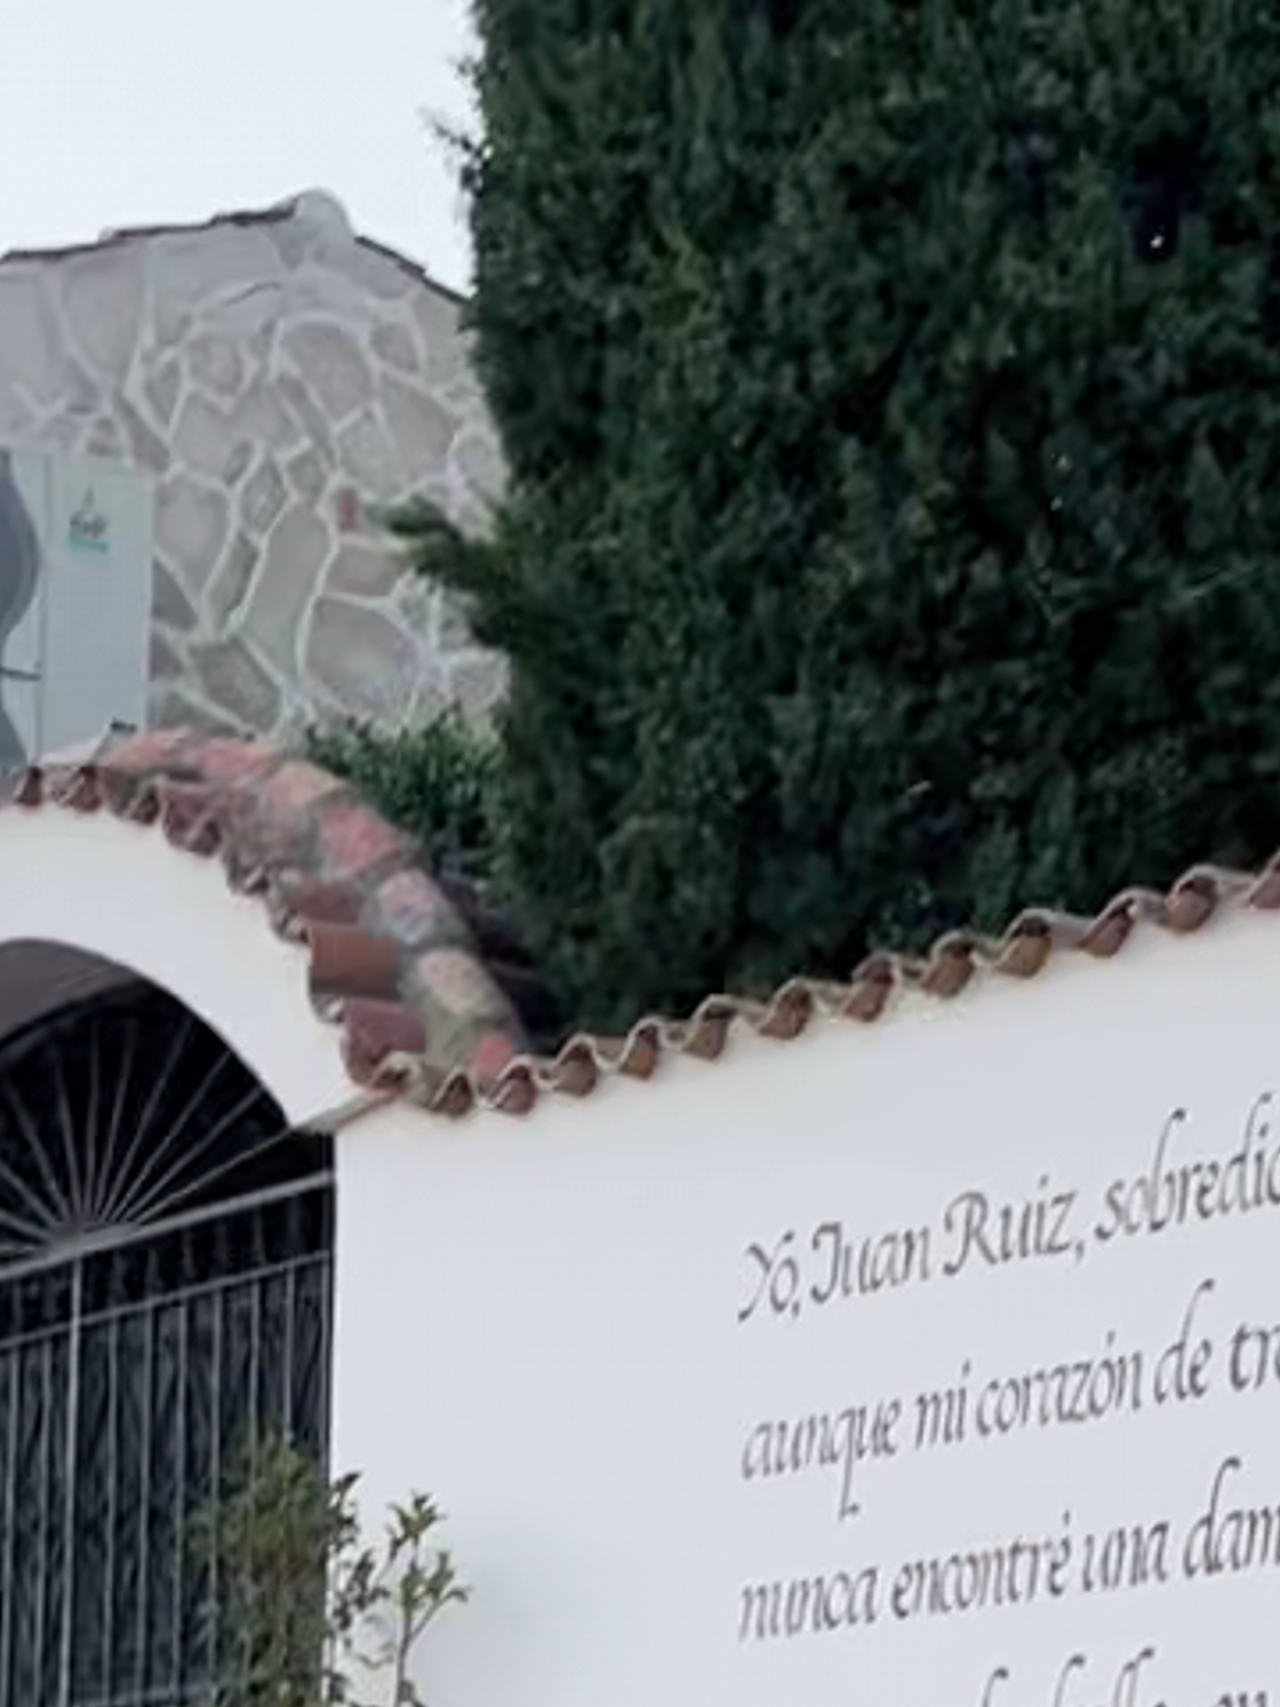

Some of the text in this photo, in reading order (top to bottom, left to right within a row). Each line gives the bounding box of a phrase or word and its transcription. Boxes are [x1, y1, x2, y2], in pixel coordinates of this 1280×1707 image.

[943, 1175, 1085, 1277] Ruiz,
[741, 1396, 902, 1521] aunque
[915, 1360, 971, 1450] mi
[975, 1331, 1143, 1438] corazón
[1153, 1278, 1213, 1406] de
[737, 1567, 878, 1641] nunca
[890, 1510, 1072, 1621] encontré
[1081, 1521, 1170, 1595] una
